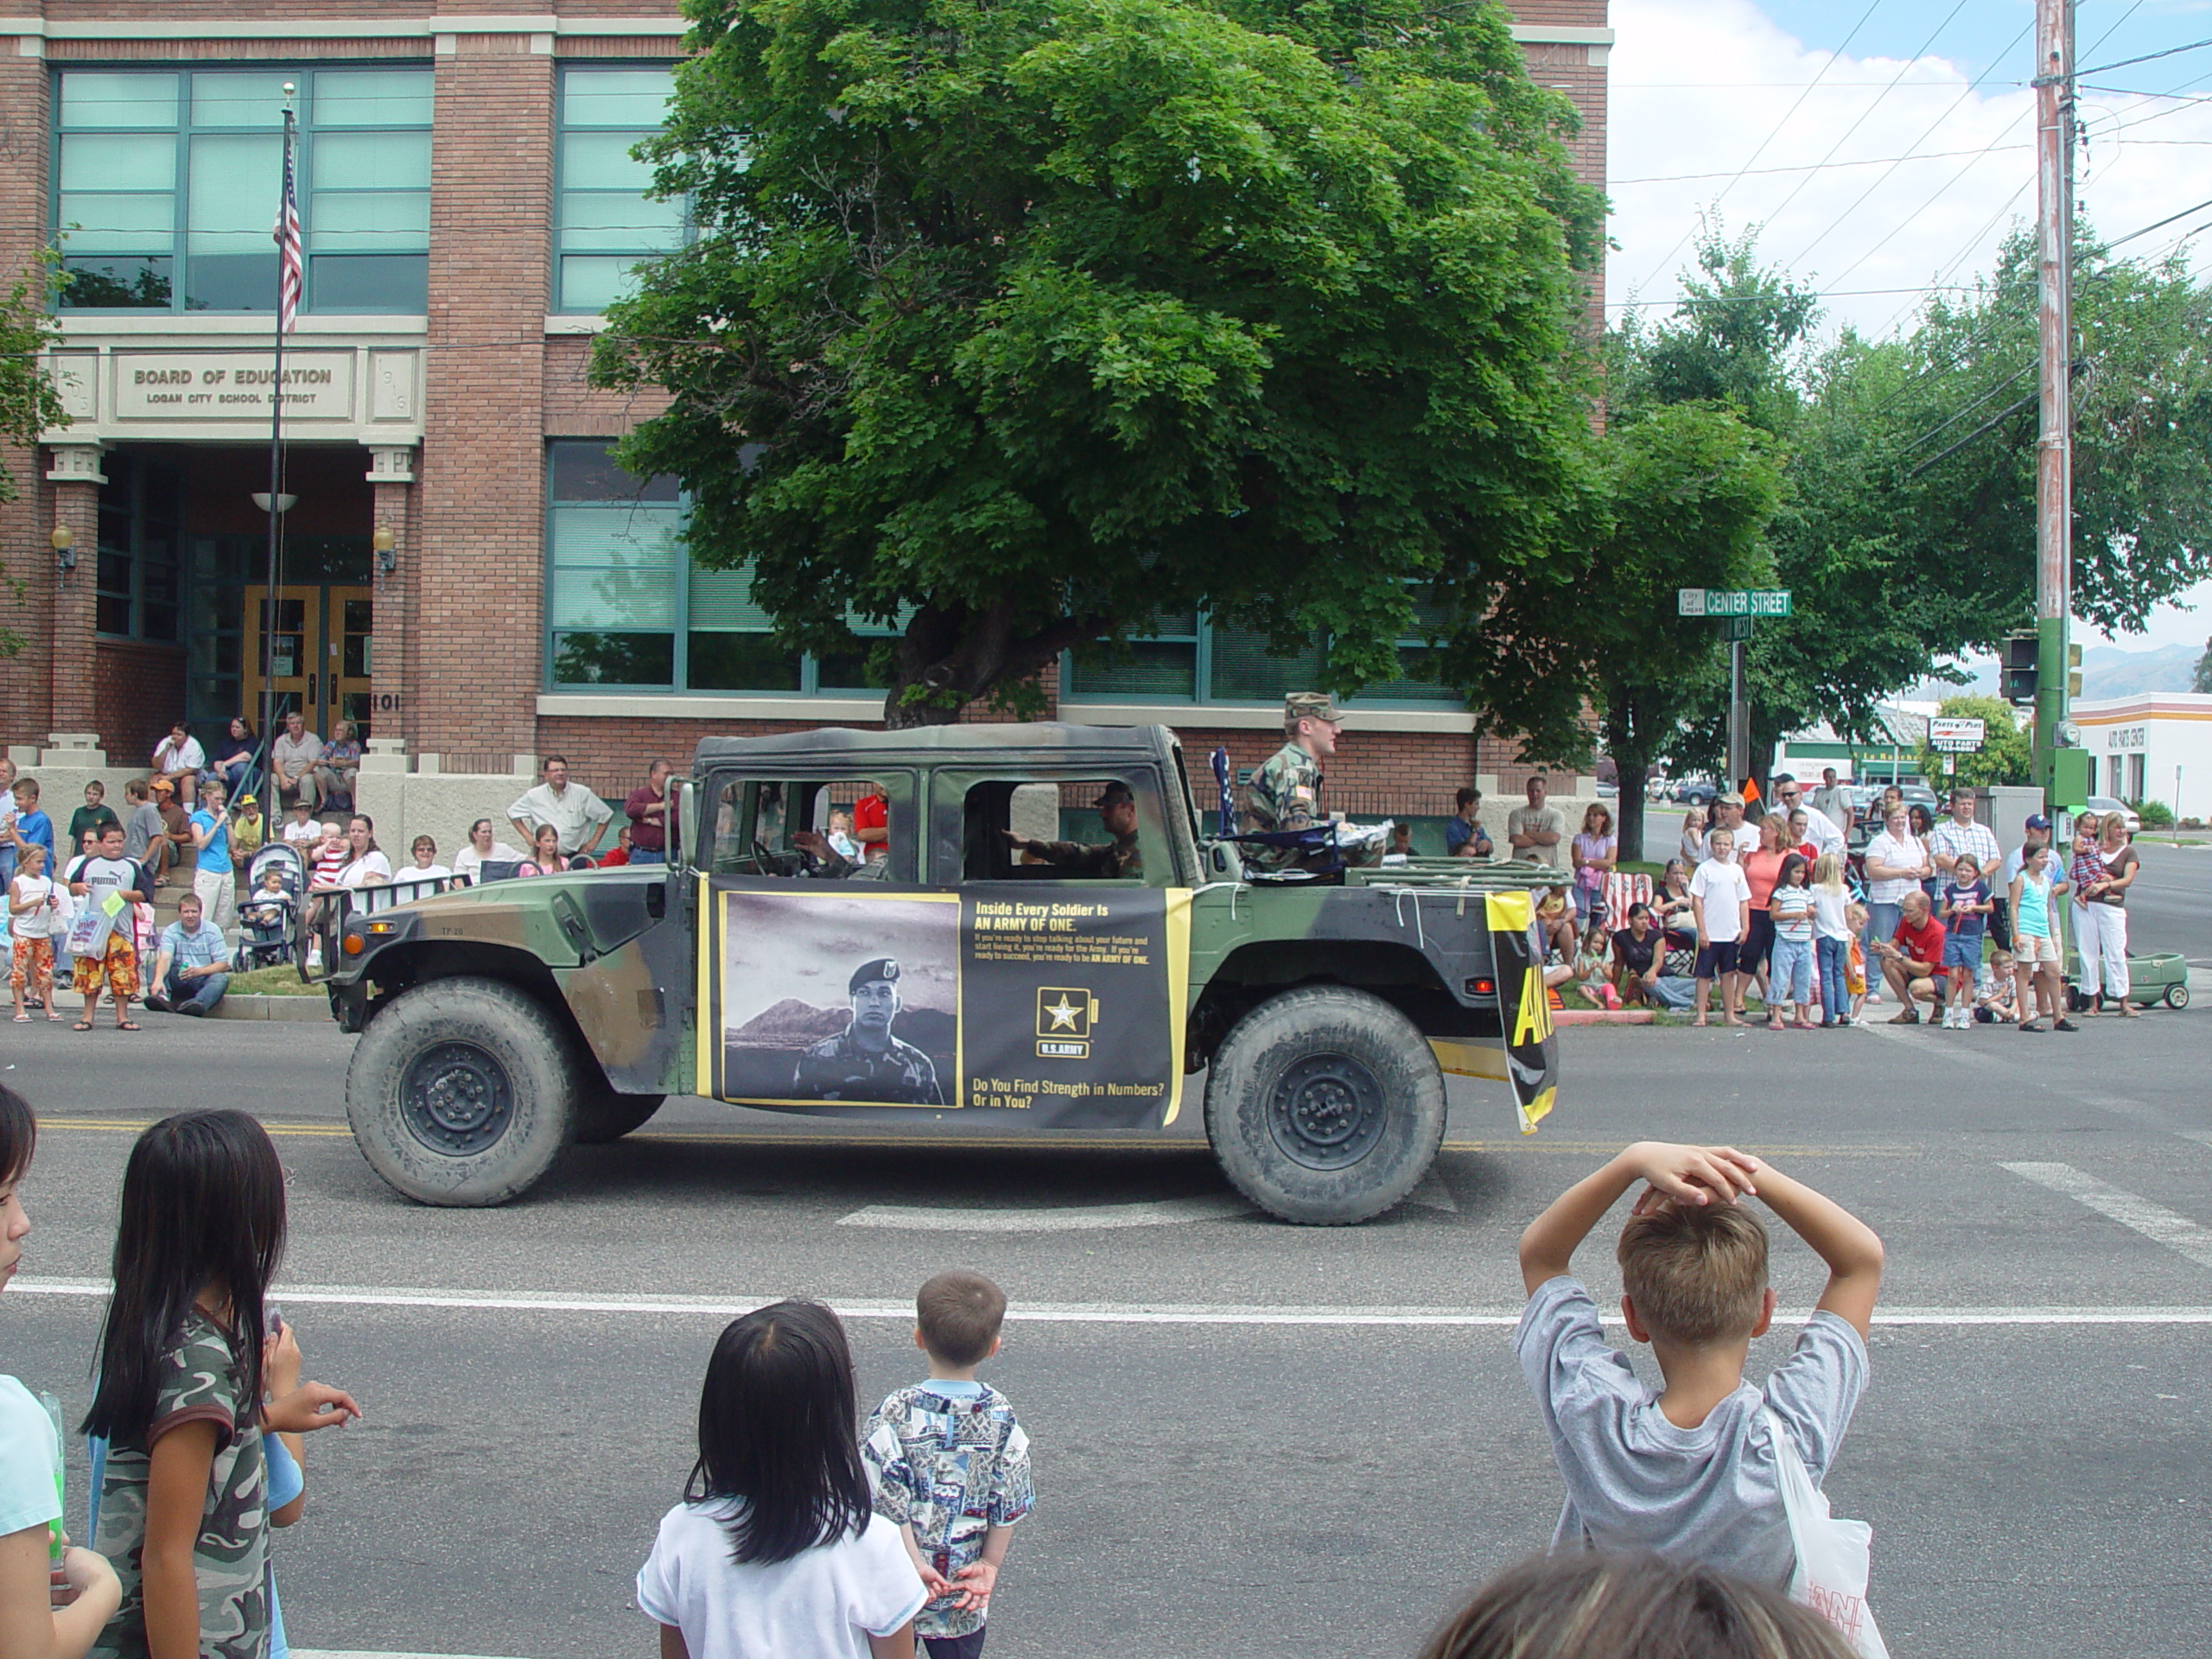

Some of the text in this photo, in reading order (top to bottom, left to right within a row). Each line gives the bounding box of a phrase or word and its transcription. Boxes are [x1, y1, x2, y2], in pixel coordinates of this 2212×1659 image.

[134, 370, 331, 384] BOARD OF EDUCATION
[147, 394, 316, 404] LOGAN CITY SCHOOL DSTRICT
[1707, 592, 1789, 613] CENTER STREET
[373, 694, 399, 710] 101
[976, 901, 1109, 918] Inside Every Soldier Is
[975, 917, 1077, 931] AN ARMY OF ONE.
[1003, 935, 1022, 944] ready
[1049, 935, 1074, 944] talking
[1096, 937, 1111, 945] your
[1112, 936, 1134, 944] future
[1134, 937, 1148, 945] and
[993, 944, 1013, 952] living
[1045, 944, 1064, 953] ready
[1076, 944, 1088, 953] the
[1111, 945, 1117, 954] If
[1117, 946, 1139, 955] you're
[975, 952, 994, 961] ready
[1033, 953, 1053, 963] you're
[1054, 954, 1072, 963] ready
[1073, 954, 1081, 963] to
[1082, 954, 1090, 963] be
[1090, 954, 1101, 963] AN
[1102, 954, 1122, 963] ARMY
[1122, 955, 1132, 964] OF
[973, 1078, 1165, 1098] Do You Find Strength in Numbers?
[973, 1094, 1033, 1109] Or in You?
